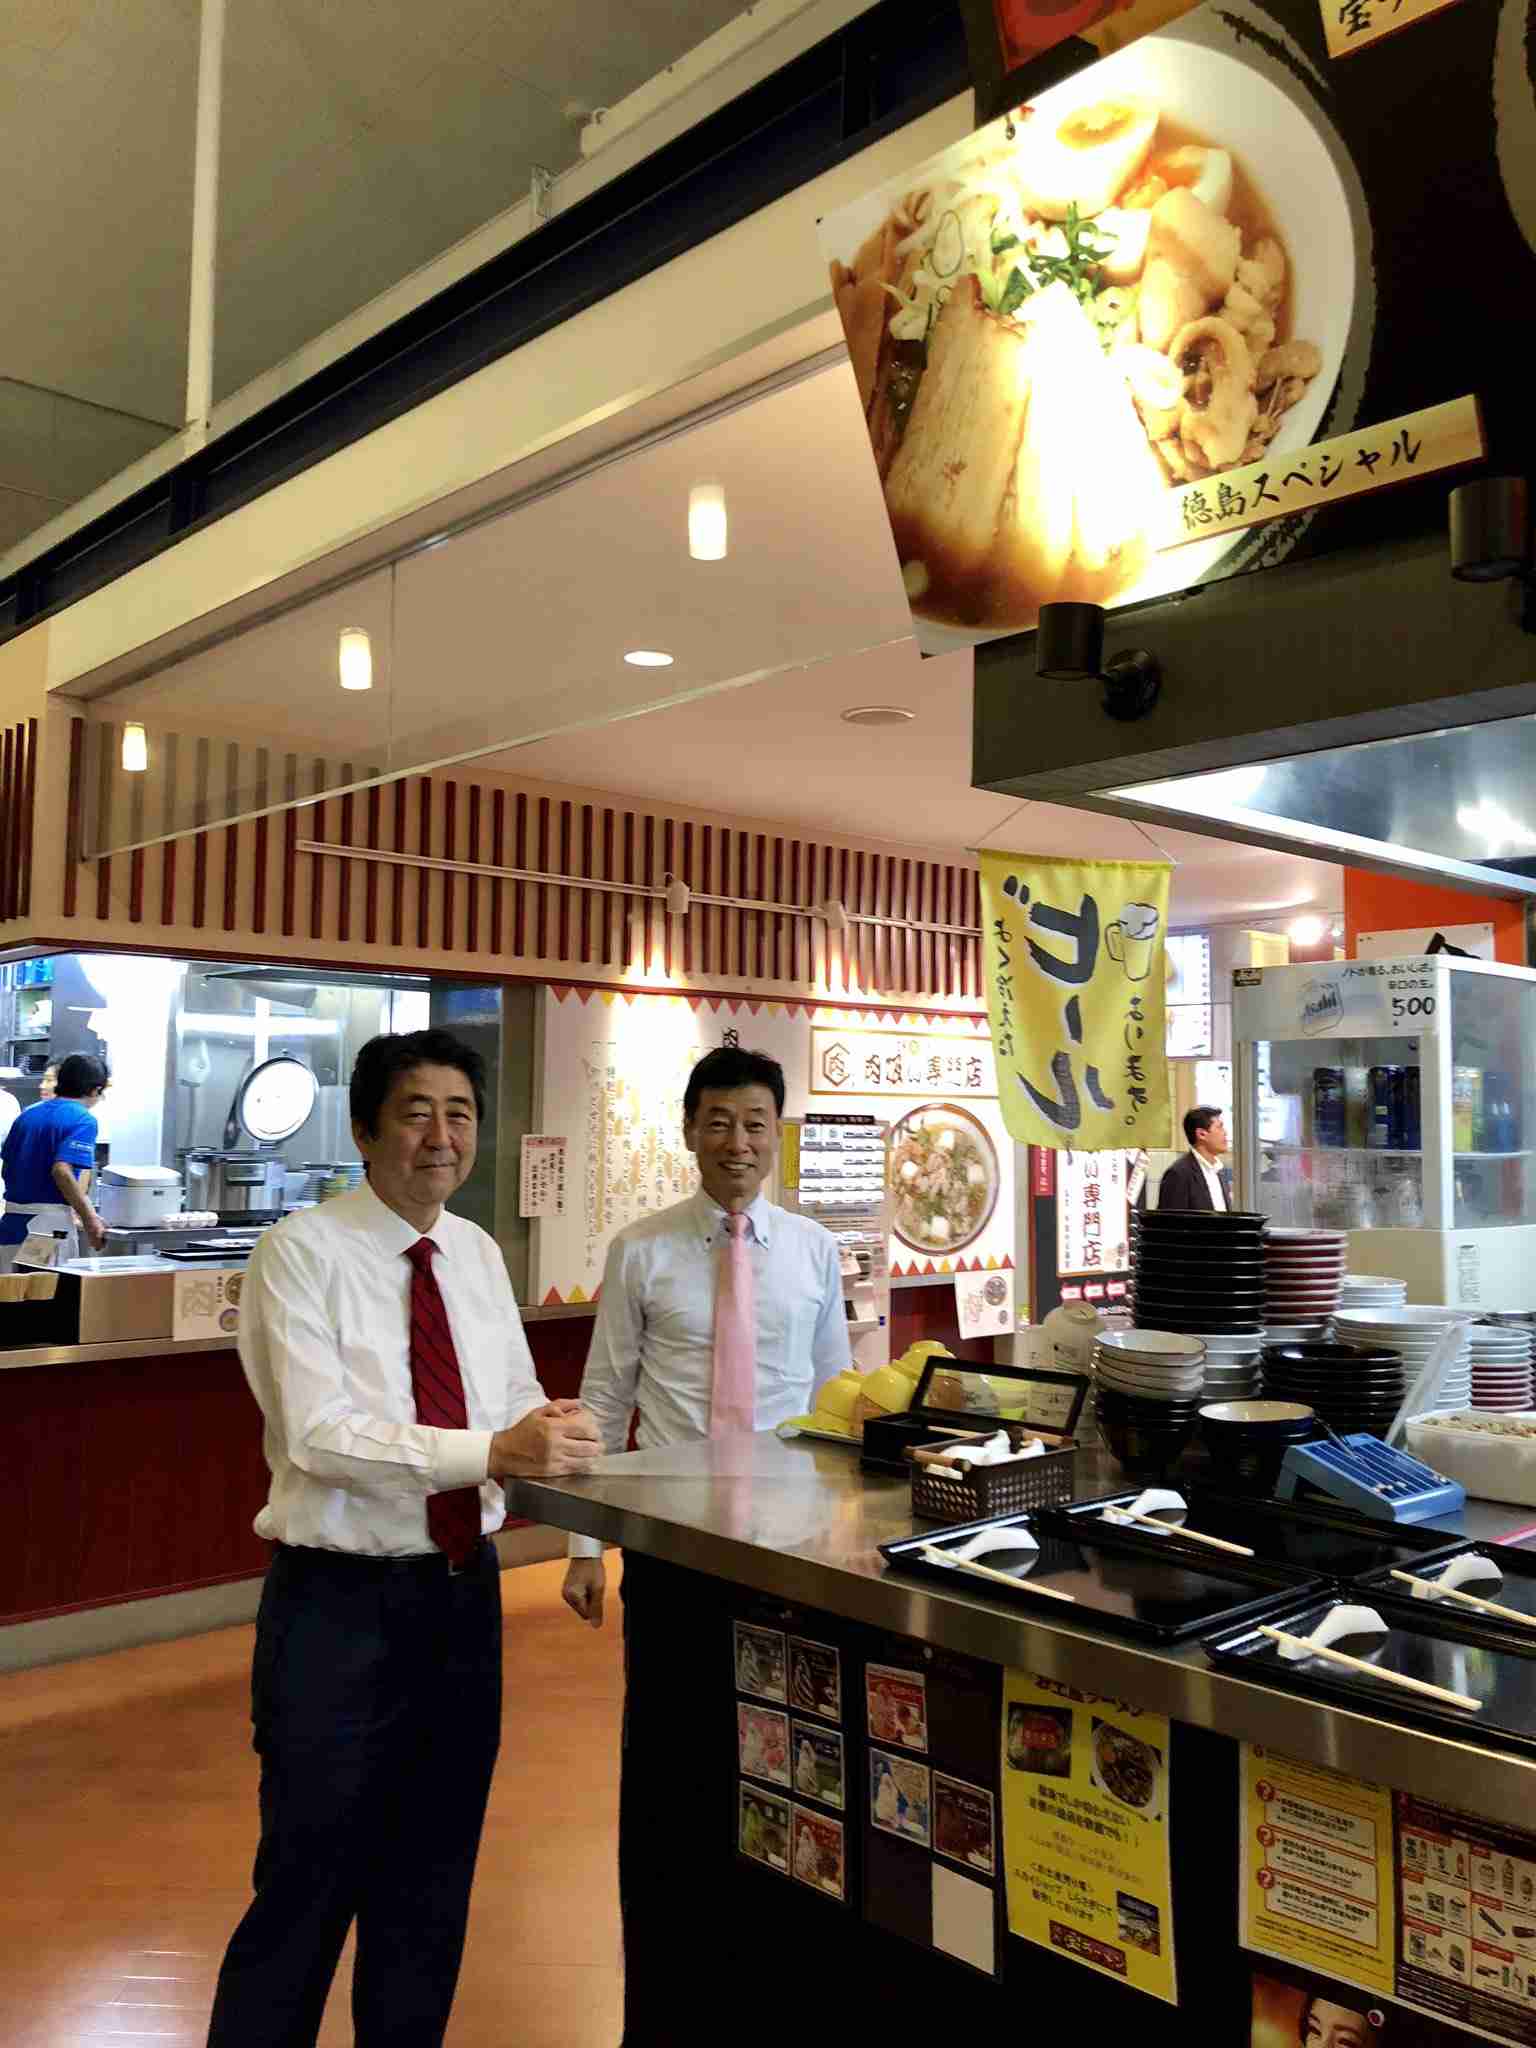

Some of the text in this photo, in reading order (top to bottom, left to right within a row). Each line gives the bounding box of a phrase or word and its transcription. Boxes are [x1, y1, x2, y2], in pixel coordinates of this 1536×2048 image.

[1182, 429, 1422, 530] 徳島スペシャル
[1391, 996, 1436, 1017] 500
